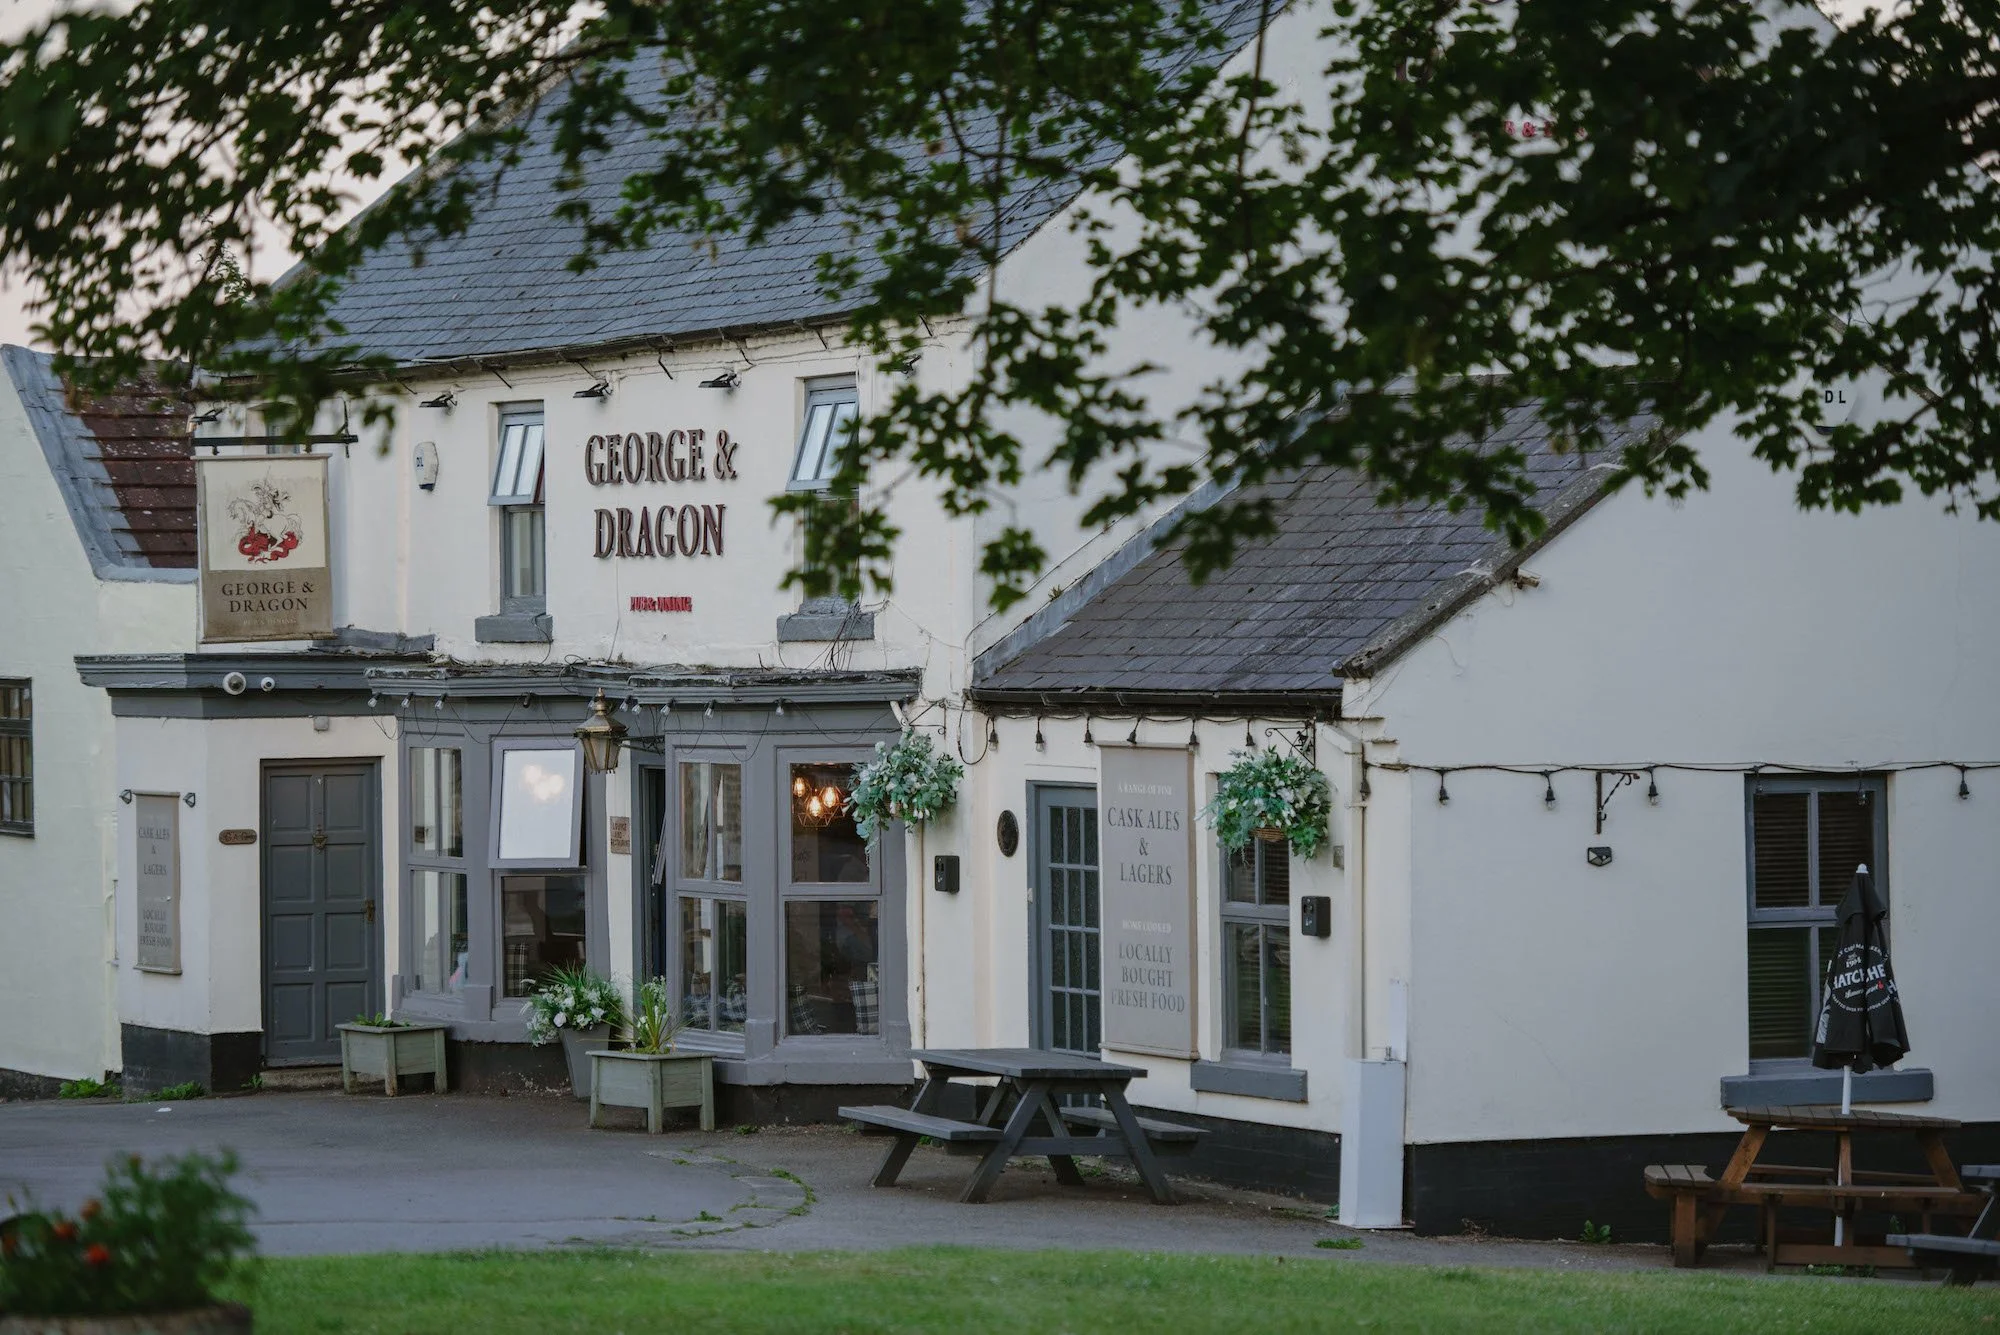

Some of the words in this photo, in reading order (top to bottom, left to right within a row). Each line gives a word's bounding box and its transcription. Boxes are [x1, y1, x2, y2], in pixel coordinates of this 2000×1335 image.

[585, 429, 705, 486] GEORGE
[713, 429, 738, 480] &
[594, 503, 727, 558] DRAGON
[221, 581, 296, 597] GEORGE
[302, 581, 314, 594] &
[229, 598, 308, 613] DRAGON
[1107, 807, 1143, 829] CASK
[1147, 809, 1181, 832] ALES
[1139, 837, 1149, 857] &
[143, 864, 167, 876] LAGERS
[1120, 863, 1172, 886] LAGERS
[1119, 943, 1172, 964] LOCALLY
[1121, 966, 1173, 988] BOUGHT
[1111, 988, 1148, 1009] FRESH
[1152, 991, 1185, 1013] FOOD
